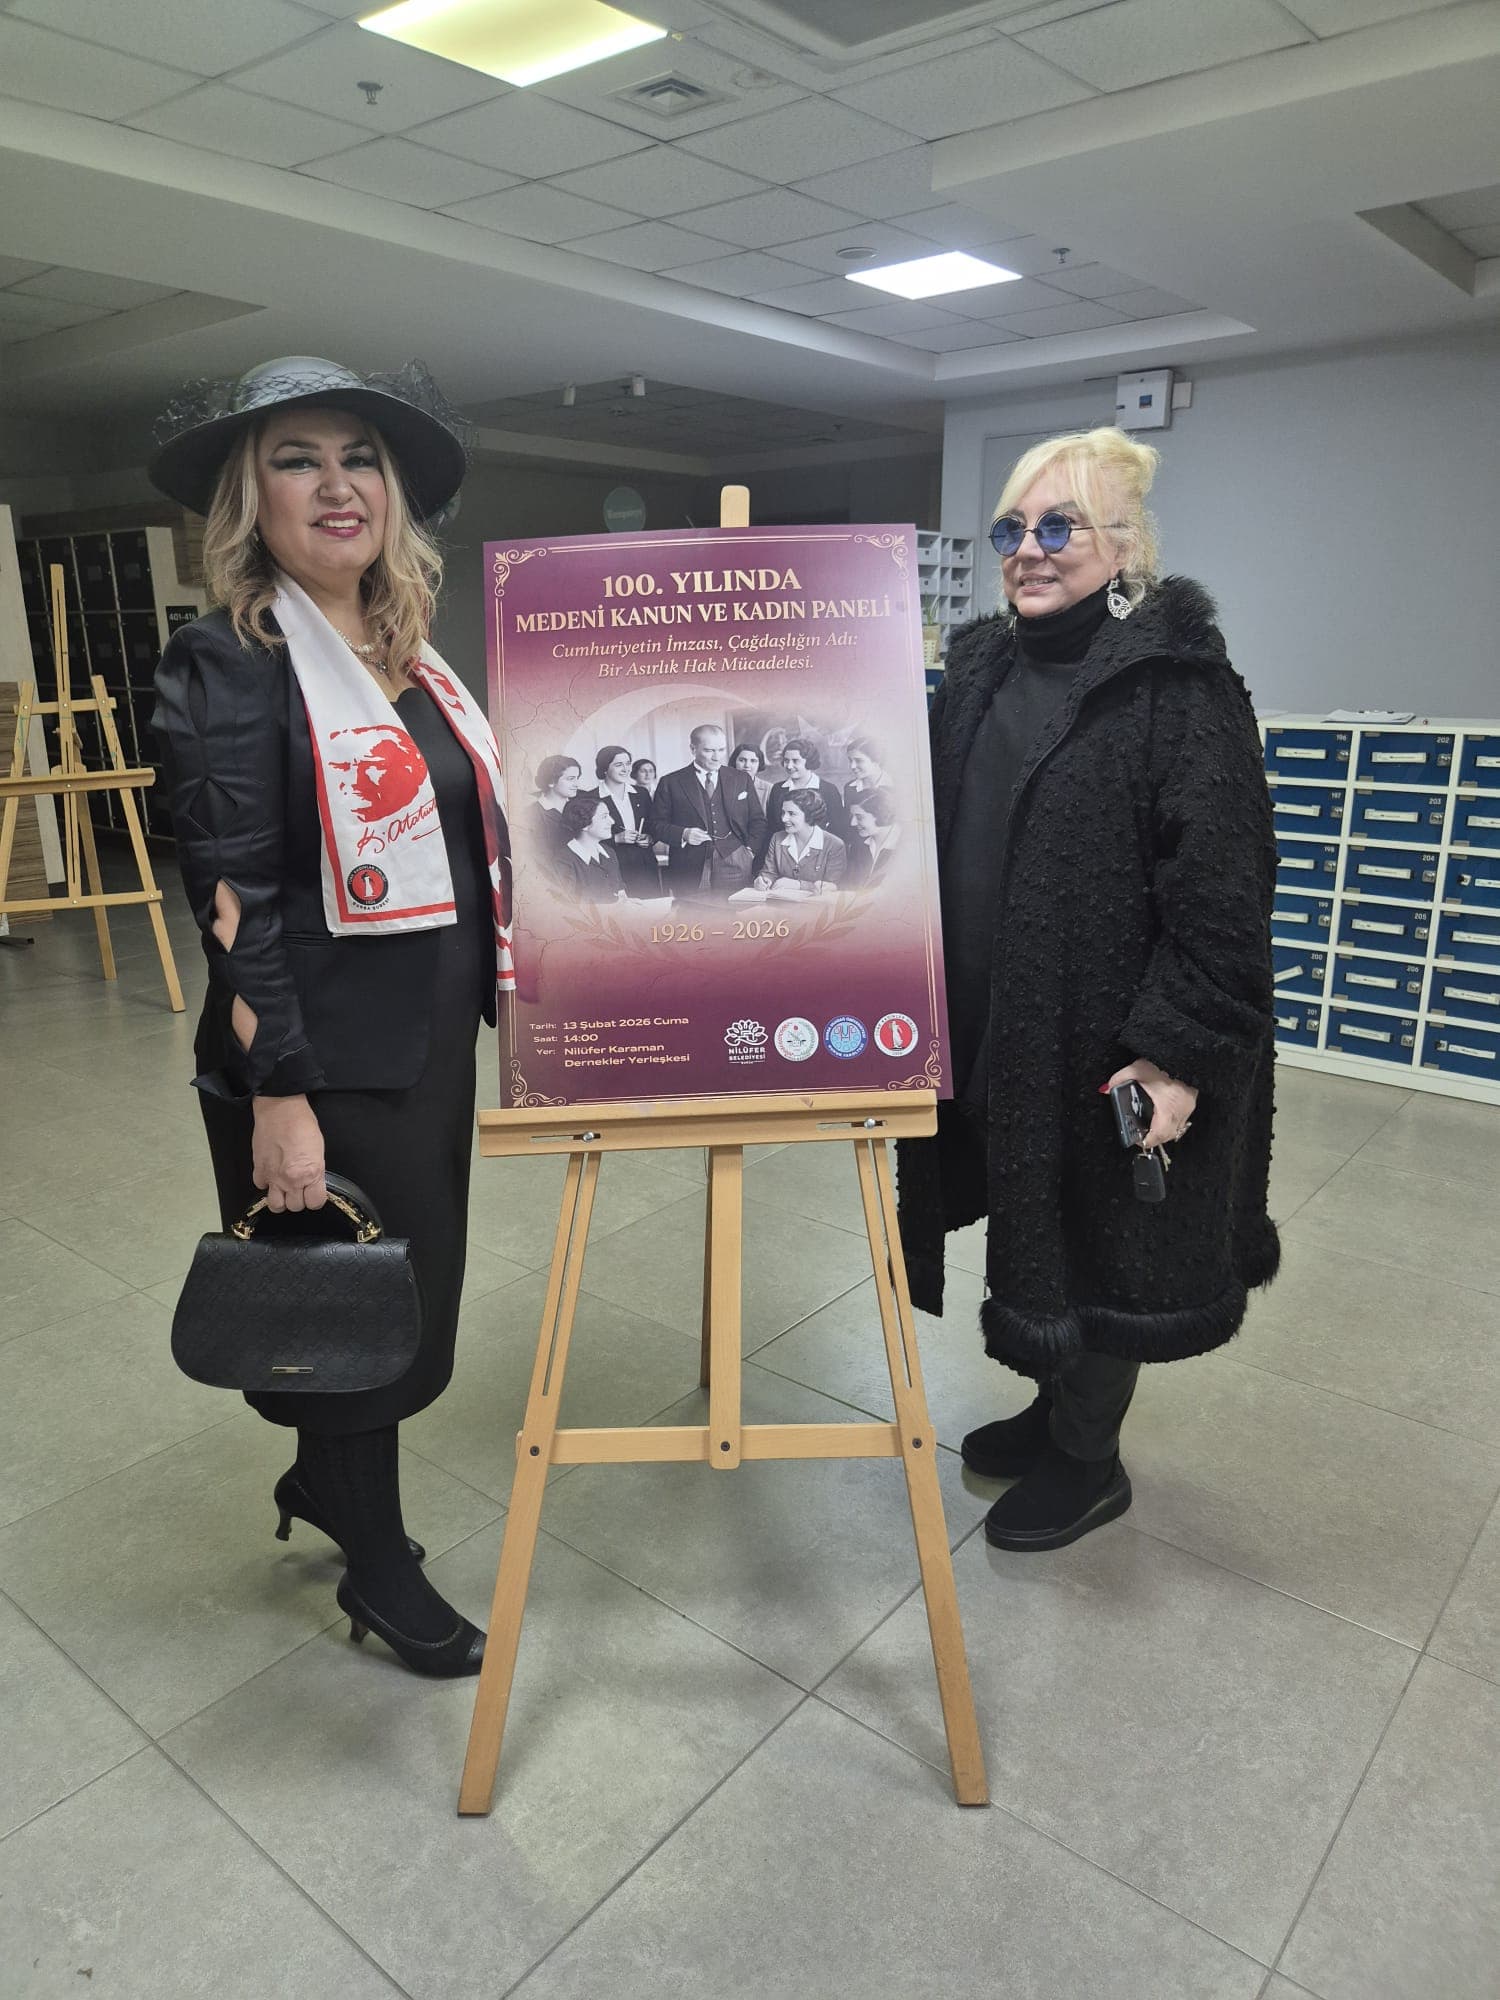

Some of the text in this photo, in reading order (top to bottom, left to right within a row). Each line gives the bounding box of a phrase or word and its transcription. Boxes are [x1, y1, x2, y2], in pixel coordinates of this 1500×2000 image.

[602, 568, 802, 598] 100. YILINDA
[515, 595, 891, 632] MEDENİ KANUN VE KADIN PANELİ
[552, 632, 858, 658] Cumhuriyetin İmzası, Çağdaşlığın Adı:
[598, 655, 814, 677] Bir Asırlık Hak Mücadelesi.
[1414, 912, 1427, 920] 205
[651, 923, 704, 943] 1926
[732, 920, 790, 939] 2026
[1311, 953, 1323, 961] 200
[563, 1022, 577, 1030] 13
[580, 1020, 616, 1030] Şubat
[619, 1018, 651, 1027] 2026
[653, 1017, 689, 1025] Cuma
[563, 1034, 598, 1043] 14:00
[564, 1047, 606, 1056] Nilüfer
[609, 1044, 665, 1053] Karaman
[729, 1046, 765, 1055] NİLÜFER
[564, 1053, 690, 1067] Dernekler Yerleşkesi
